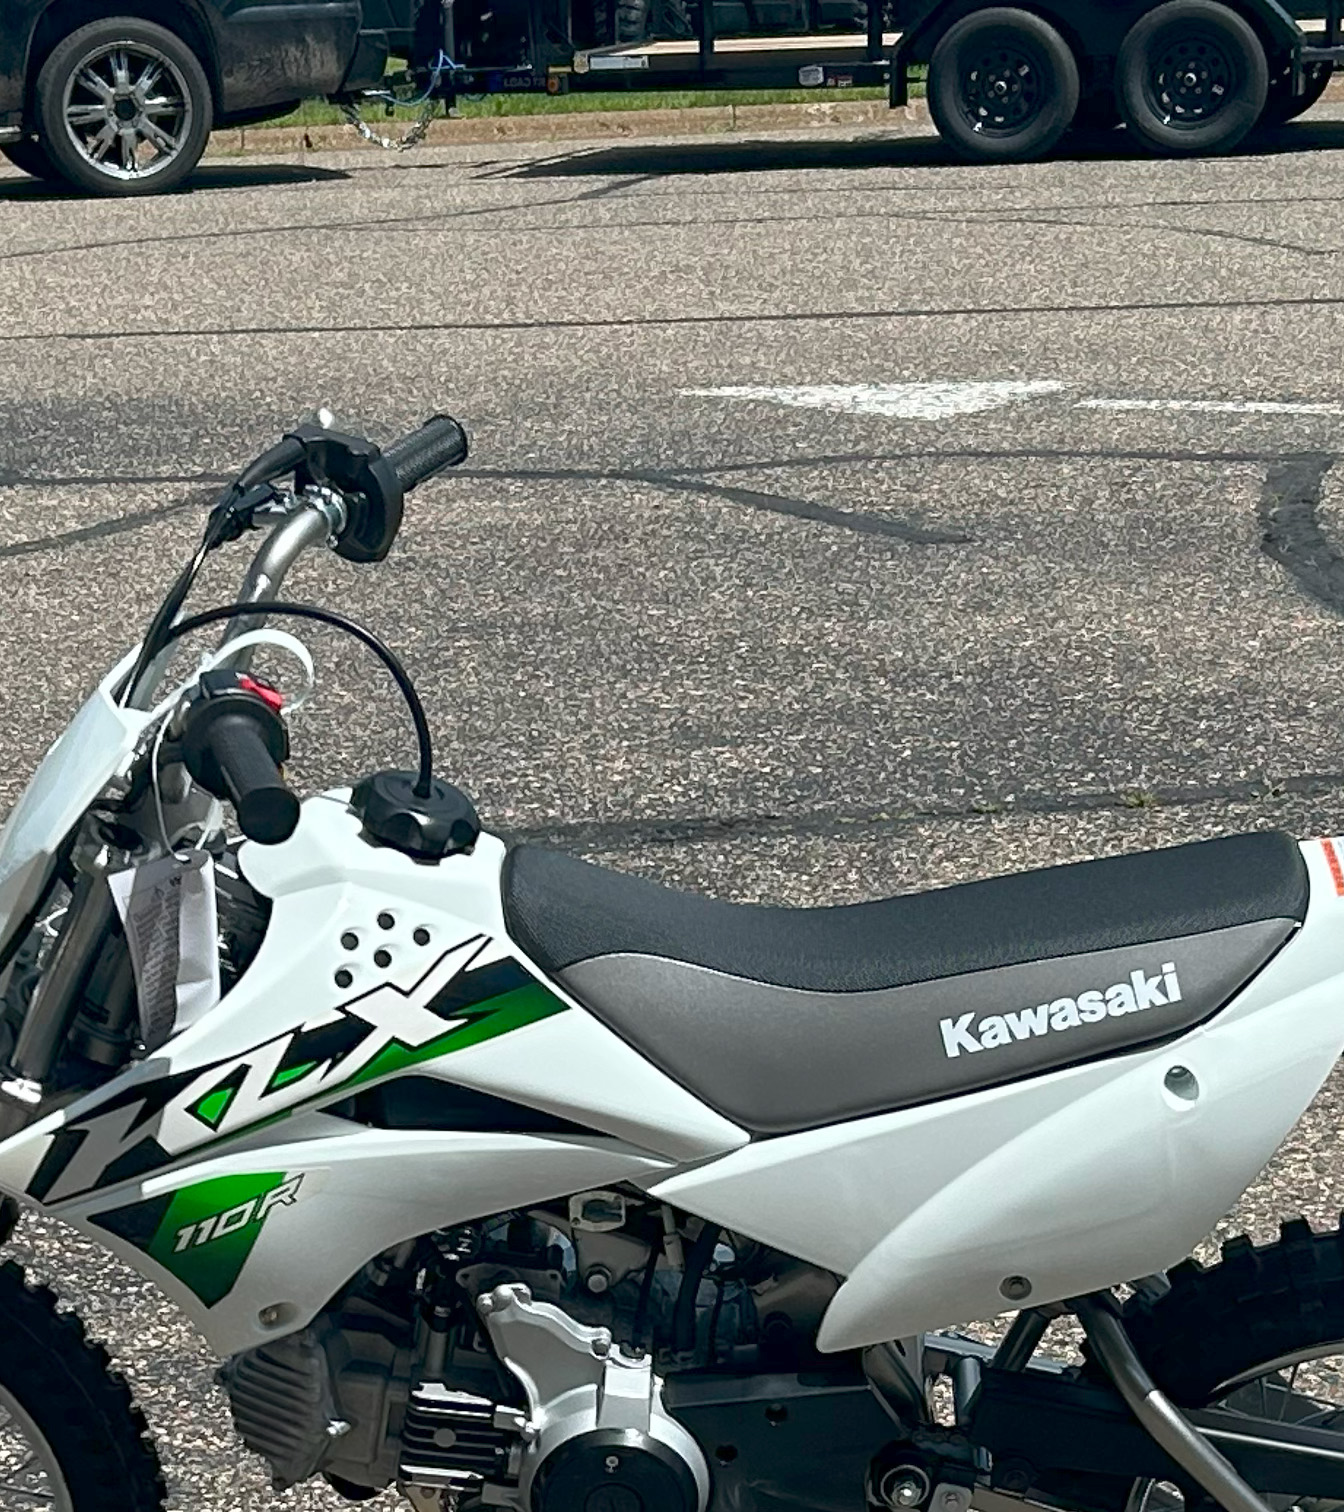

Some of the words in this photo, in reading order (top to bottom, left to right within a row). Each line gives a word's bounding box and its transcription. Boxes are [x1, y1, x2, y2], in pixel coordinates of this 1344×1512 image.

[939, 961, 1183, 1058] Kawasaki
[25, 934, 494, 1206] KLX
[173, 1171, 306, 1253] 110R
